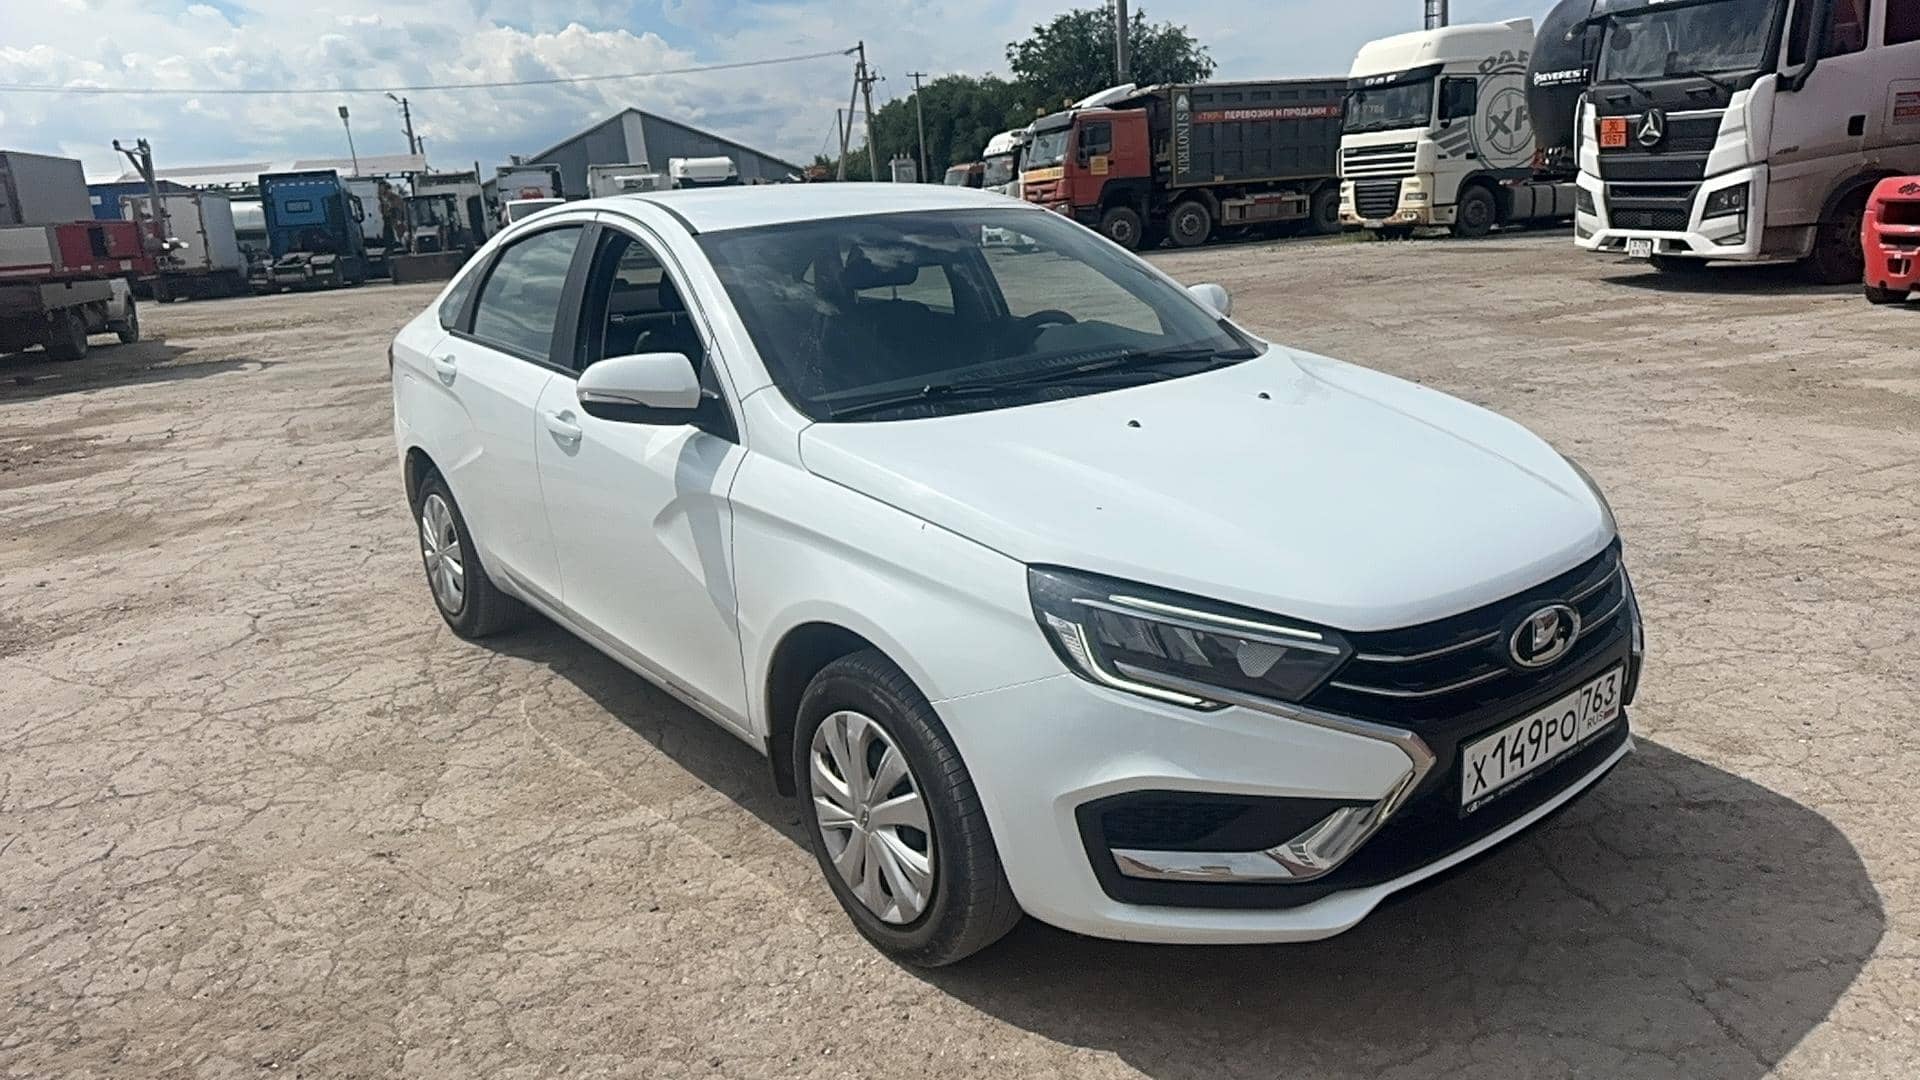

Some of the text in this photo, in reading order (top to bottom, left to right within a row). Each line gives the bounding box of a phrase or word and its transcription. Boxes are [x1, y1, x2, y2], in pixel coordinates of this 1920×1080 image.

[1364, 74, 1397, 87] DAF
[1224, 108, 1274, 120] ПЕРЕВОЗКИ
[1283, 106, 1327, 118] ПРОДАЖИ
[1176, 112, 1190, 175] SINOTRUK
[1587, 710, 1604, 729] RUS
[1471, 710, 1577, 796] Х149РО
[1582, 674, 1616, 721] 763
